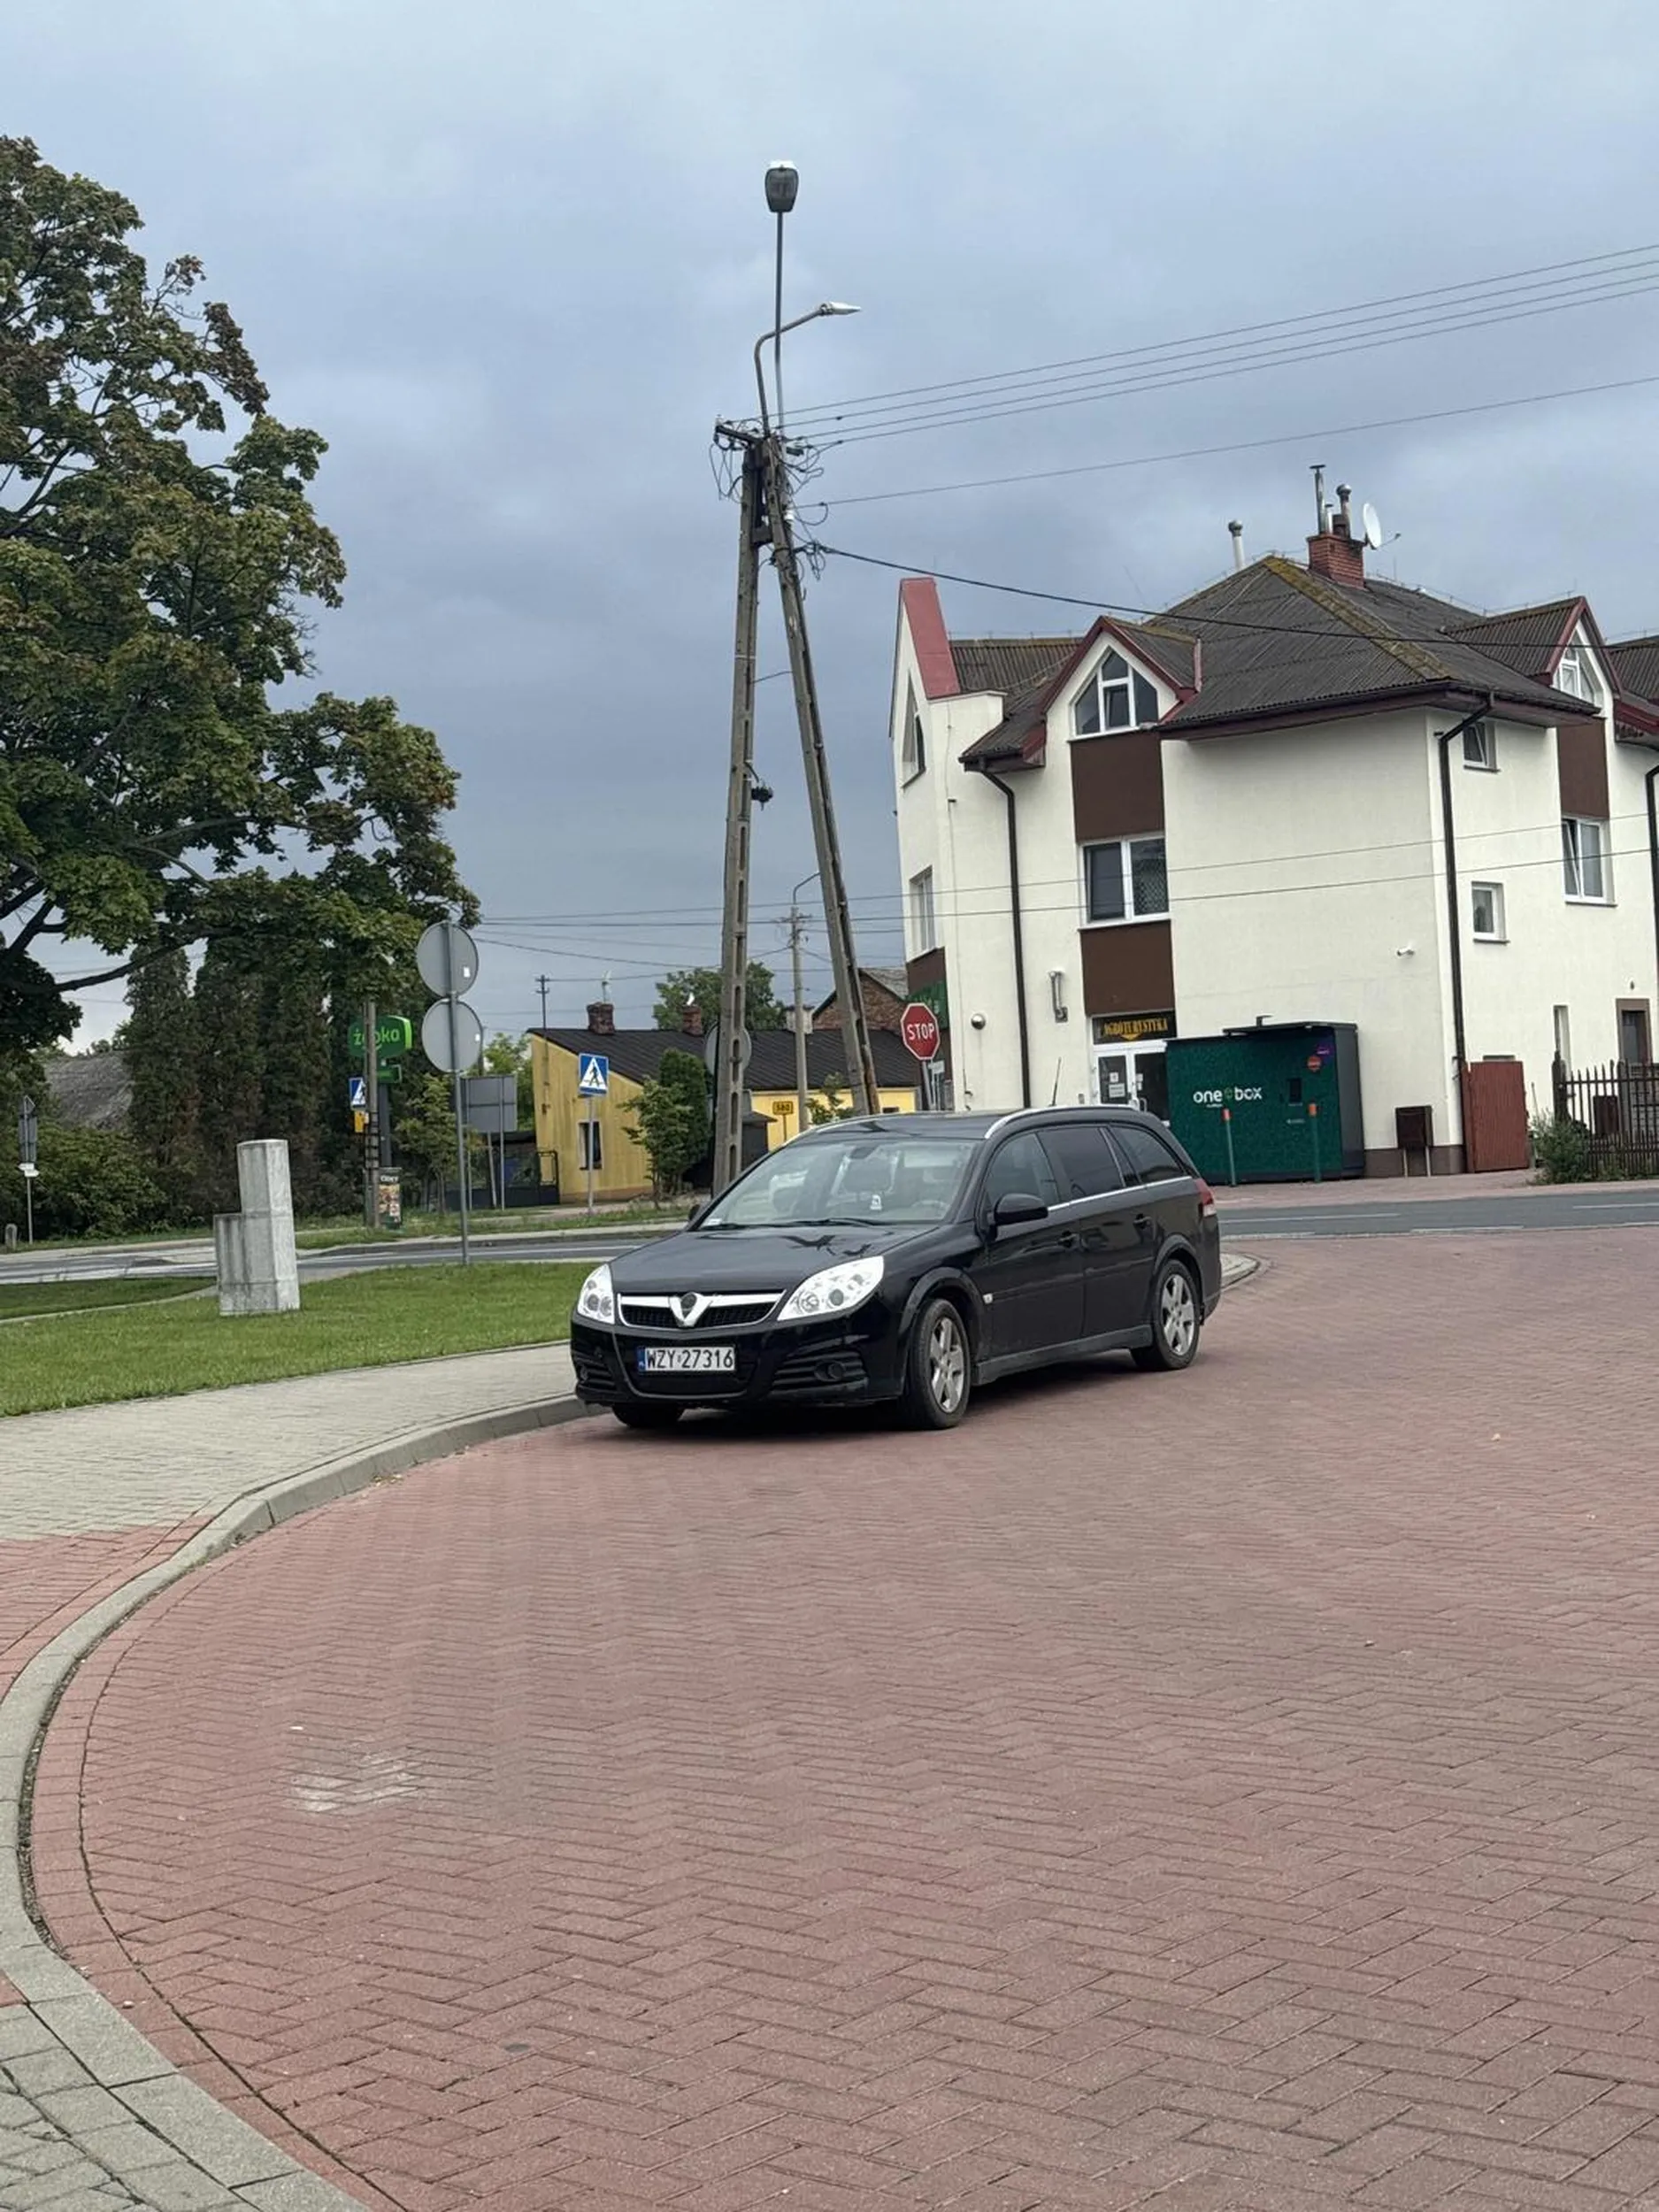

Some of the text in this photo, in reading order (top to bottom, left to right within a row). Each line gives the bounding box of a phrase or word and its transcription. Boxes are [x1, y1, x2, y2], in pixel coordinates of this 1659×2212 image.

[906, 1023, 935, 1041] STOP
[1193, 1087, 1262, 1103] one box
[647, 1348, 733, 1369] WZY 27316
